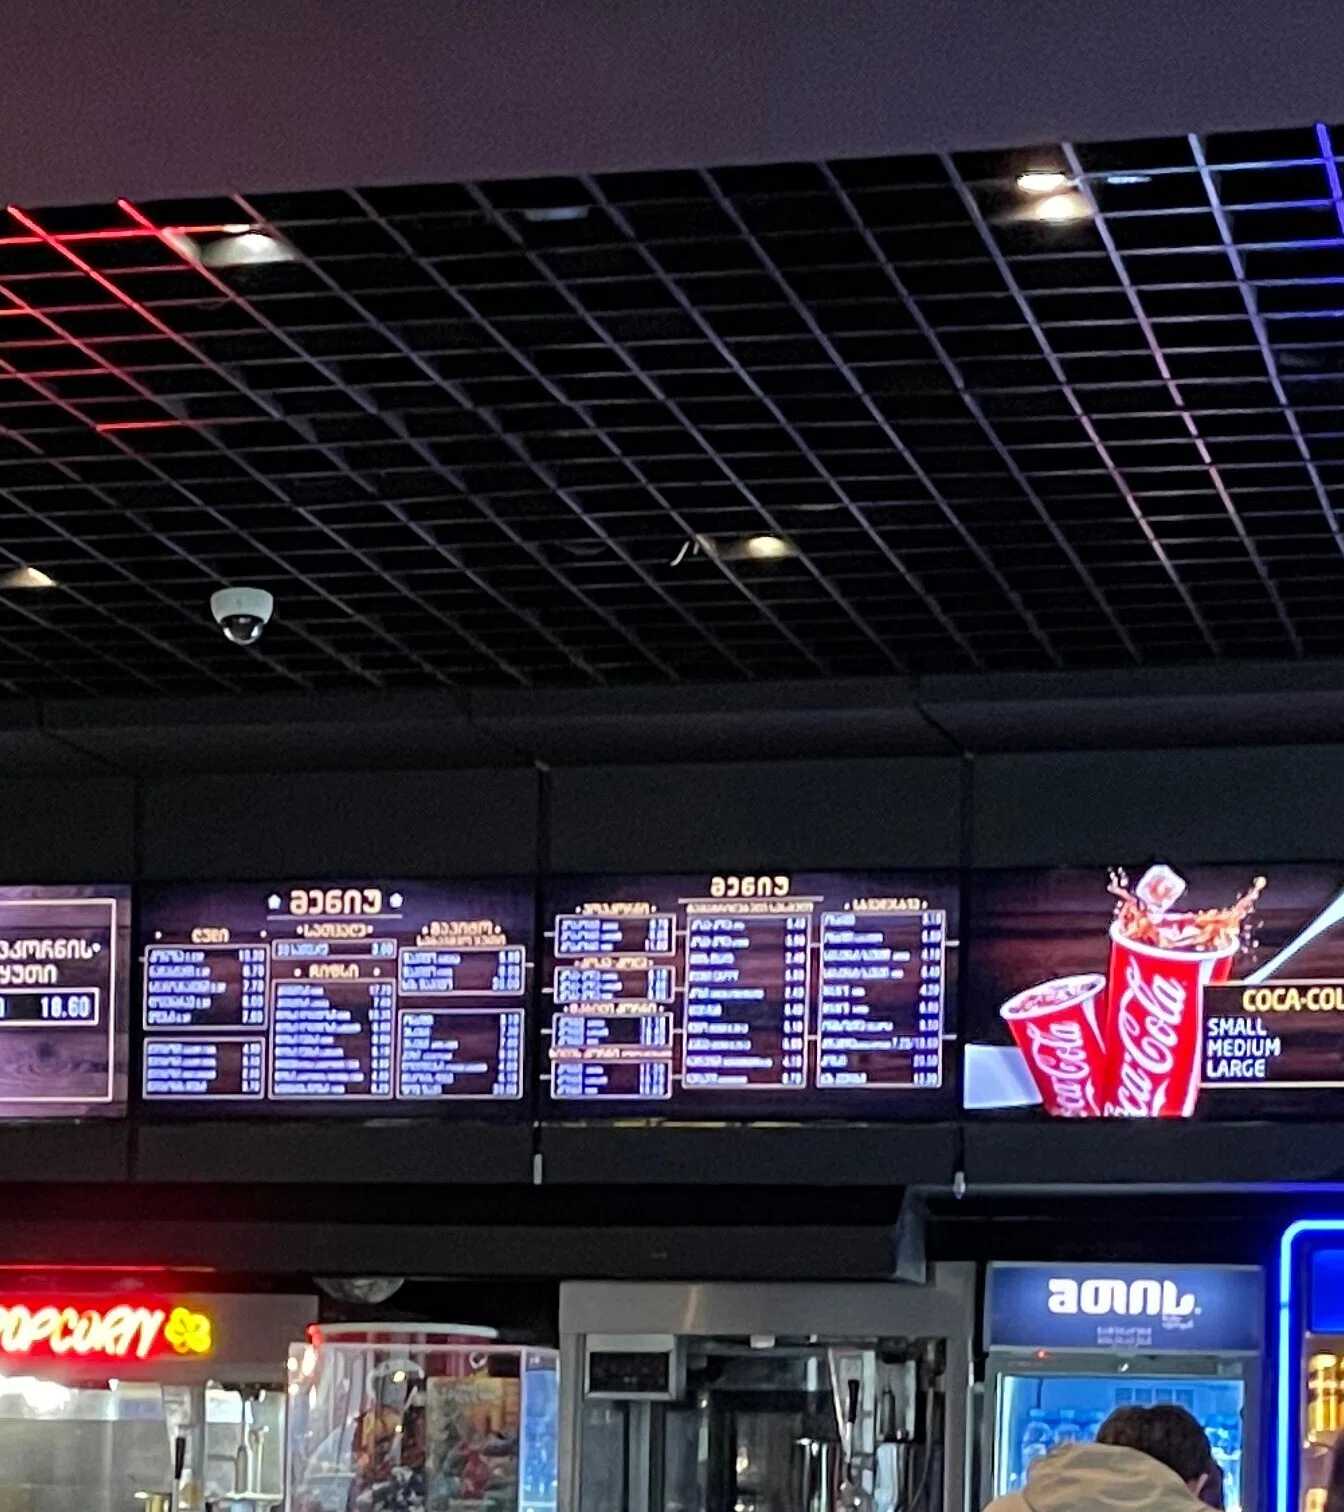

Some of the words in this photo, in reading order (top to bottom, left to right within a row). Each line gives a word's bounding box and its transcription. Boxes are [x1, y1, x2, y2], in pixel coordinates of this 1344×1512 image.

[711, 875, 790, 897] მენიუ
[290, 888, 382, 915] მენიუ
[1207, 1017, 1268, 1036] SMALL
[1207, 1038, 1281, 1057] MEDIUM
[1206, 1058, 1267, 1078] LARGE
